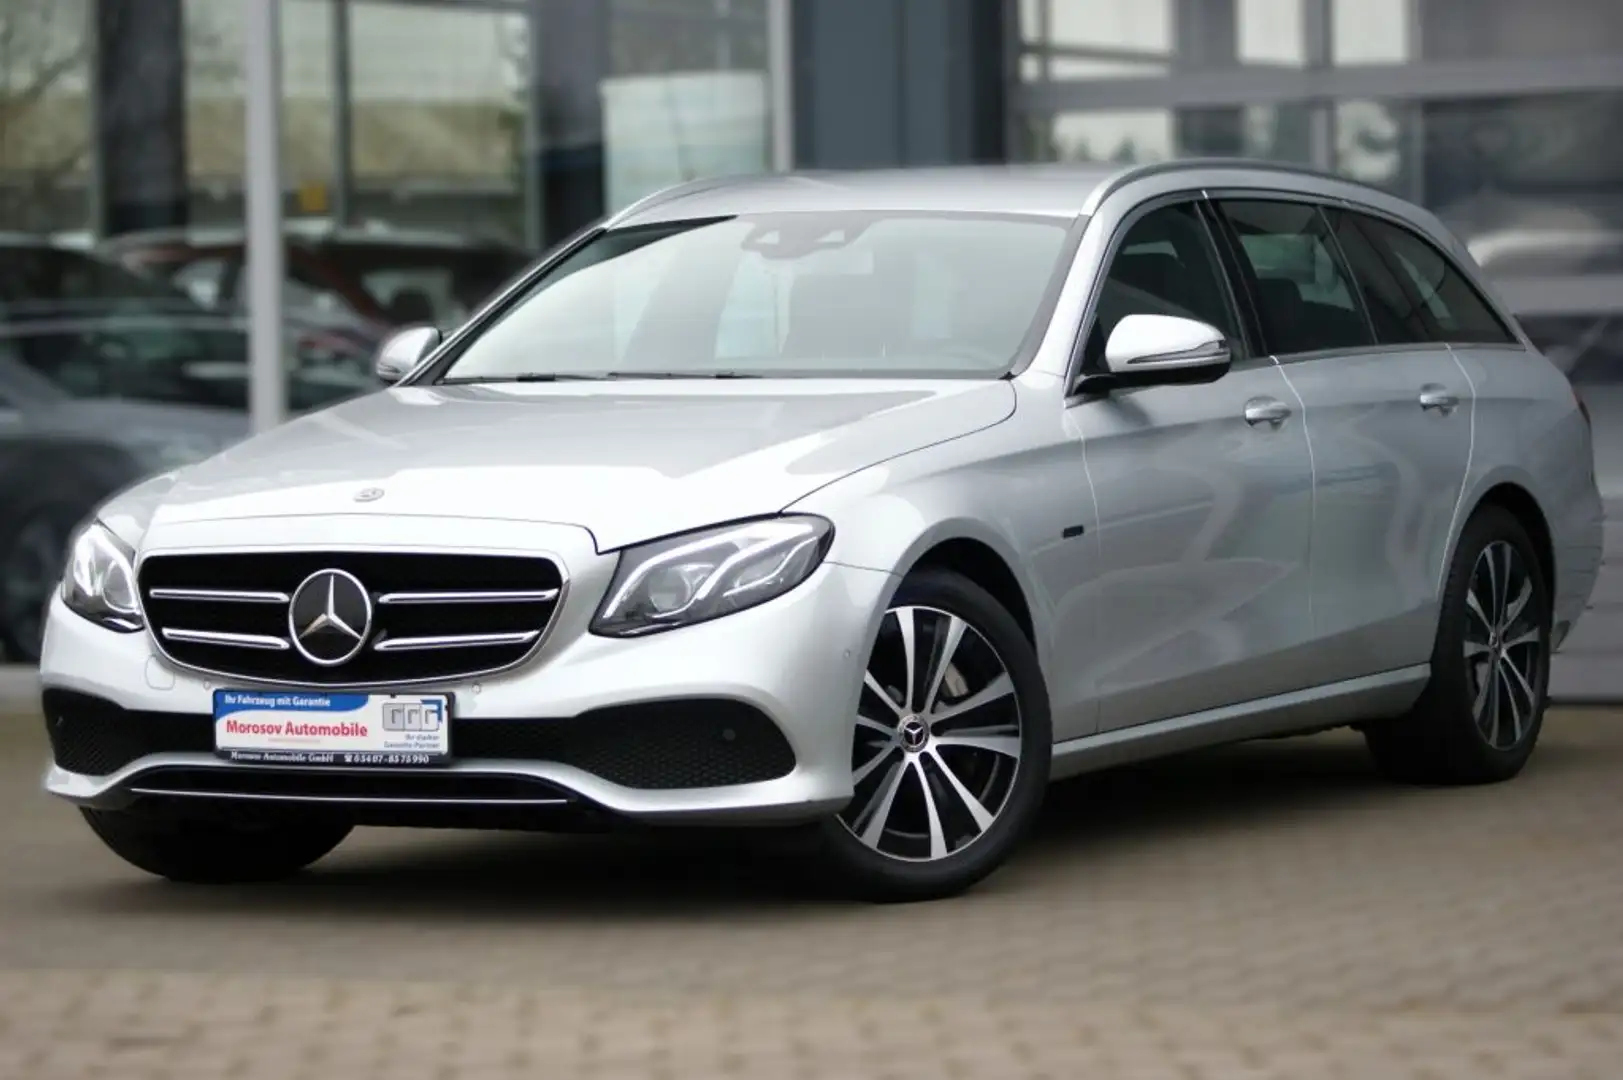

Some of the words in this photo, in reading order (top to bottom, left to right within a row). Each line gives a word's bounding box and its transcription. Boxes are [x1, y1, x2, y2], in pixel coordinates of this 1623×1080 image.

[225, 694, 236, 704] Ihr
[238, 694, 275, 708] Fahrzeug
[276, 696, 292, 706] mit
[292, 696, 331, 707] Garantie
[226, 720, 282, 734] Morosov
[285, 721, 368, 737] Automobile
[263, 752, 306, 762] Automobile
[308, 753, 334, 763] GmbH
